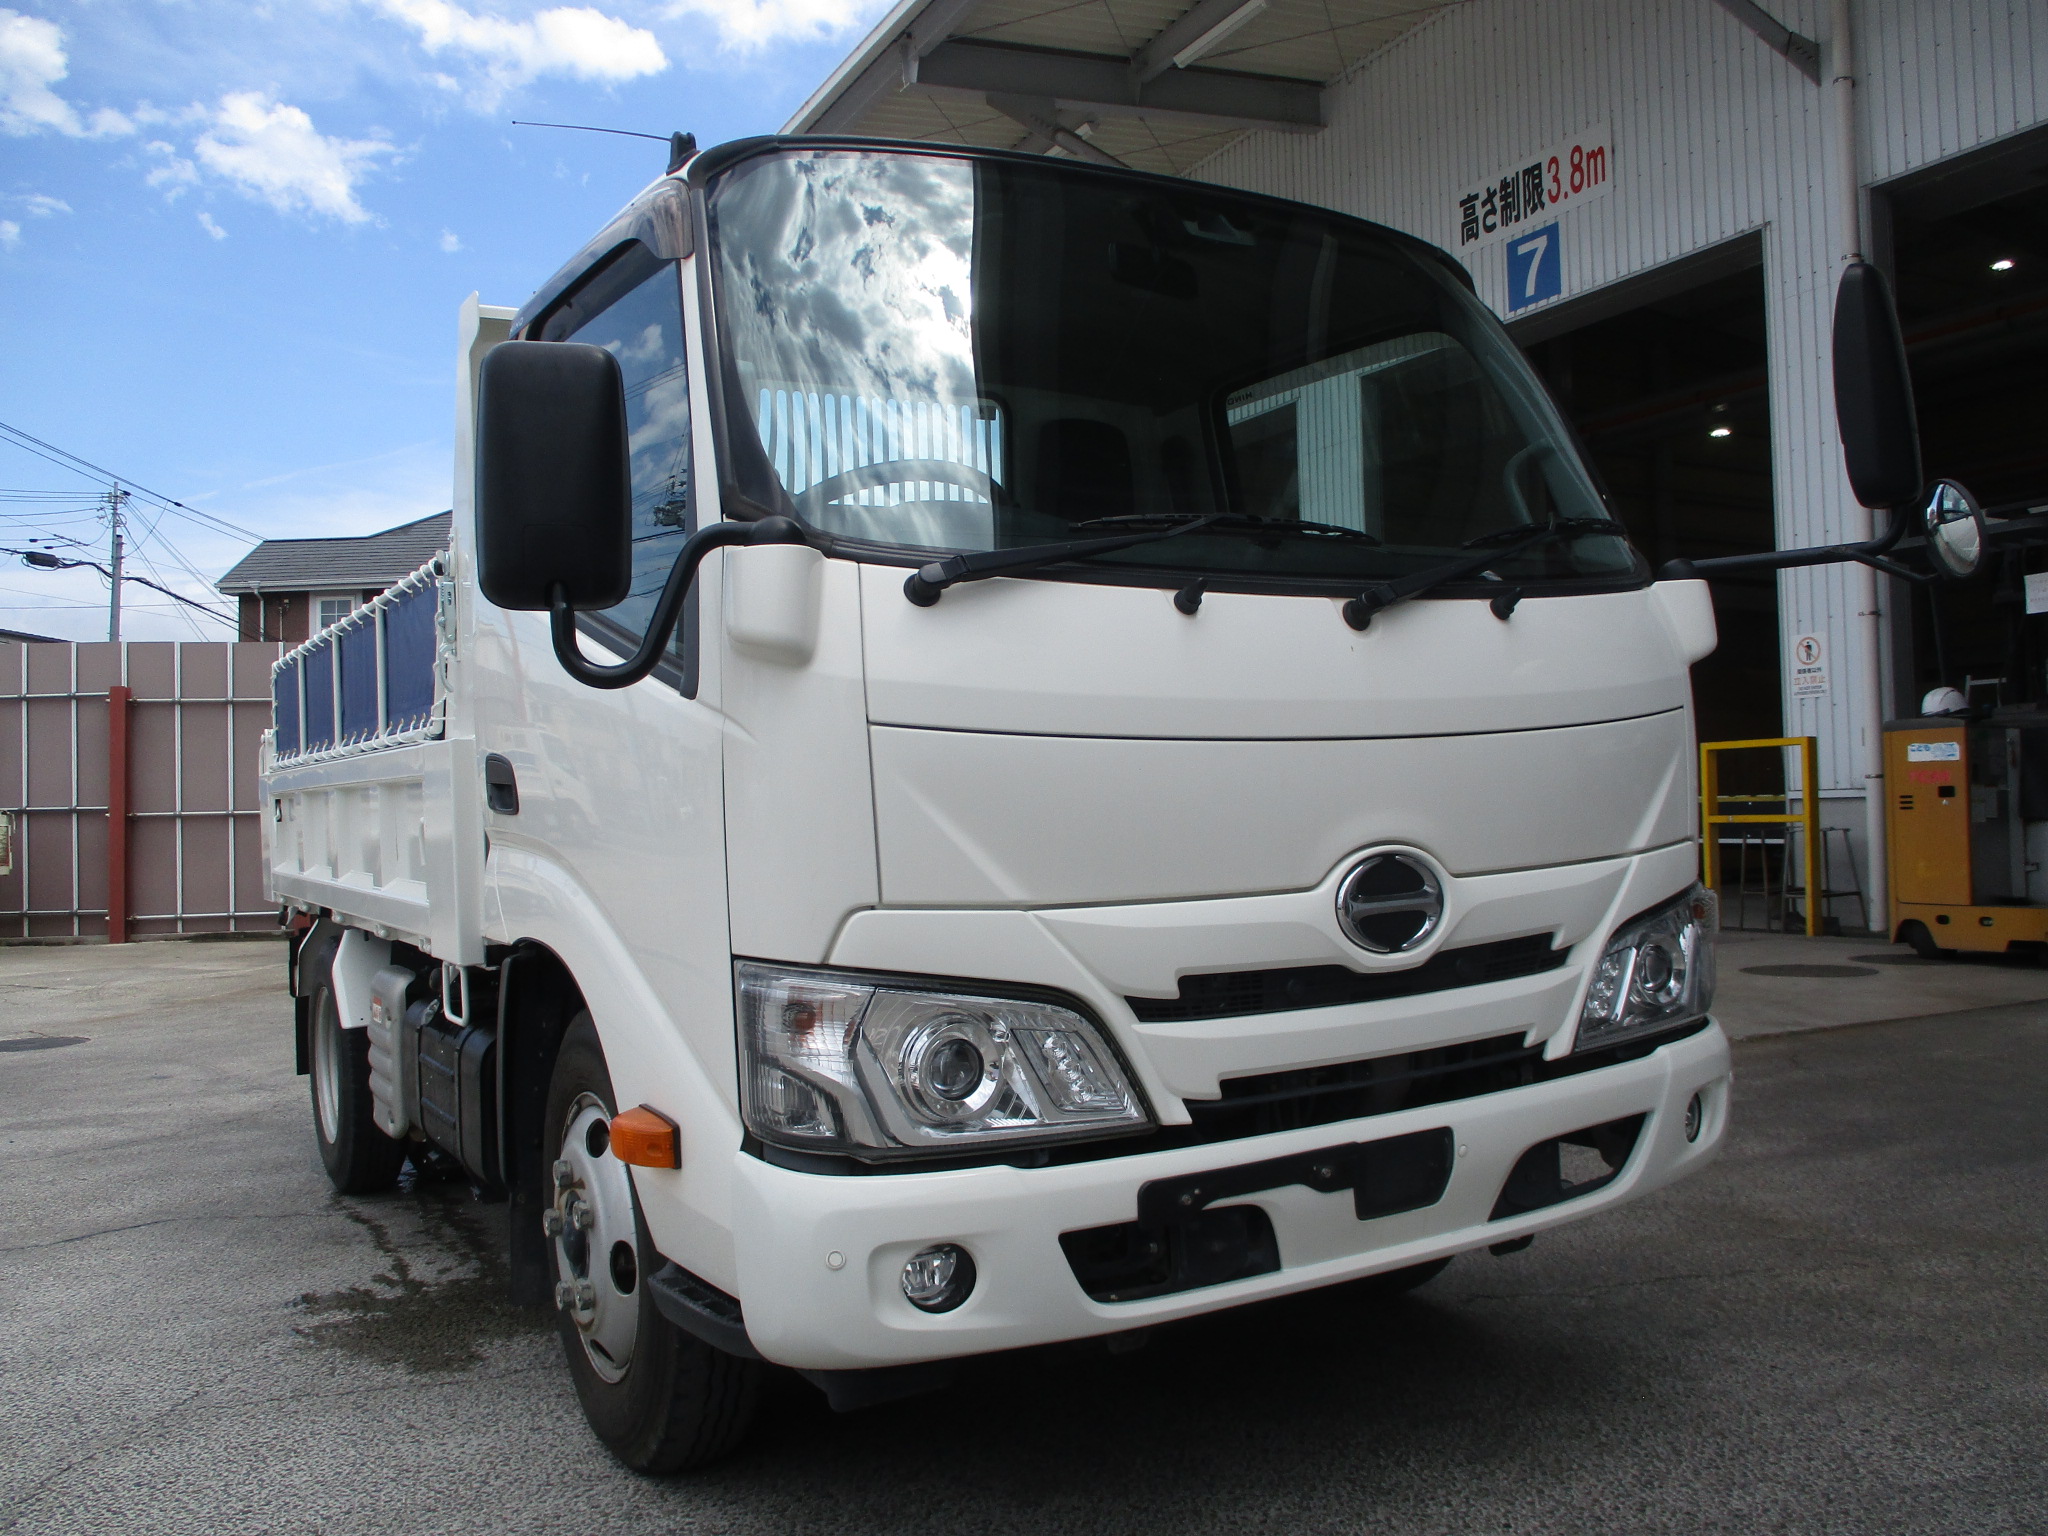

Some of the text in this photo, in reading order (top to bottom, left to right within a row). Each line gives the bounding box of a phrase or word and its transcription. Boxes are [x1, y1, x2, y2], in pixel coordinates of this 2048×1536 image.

[1459, 145, 1606, 246] 高さ制限3.8m
[1517, 234, 1548, 298] 7
